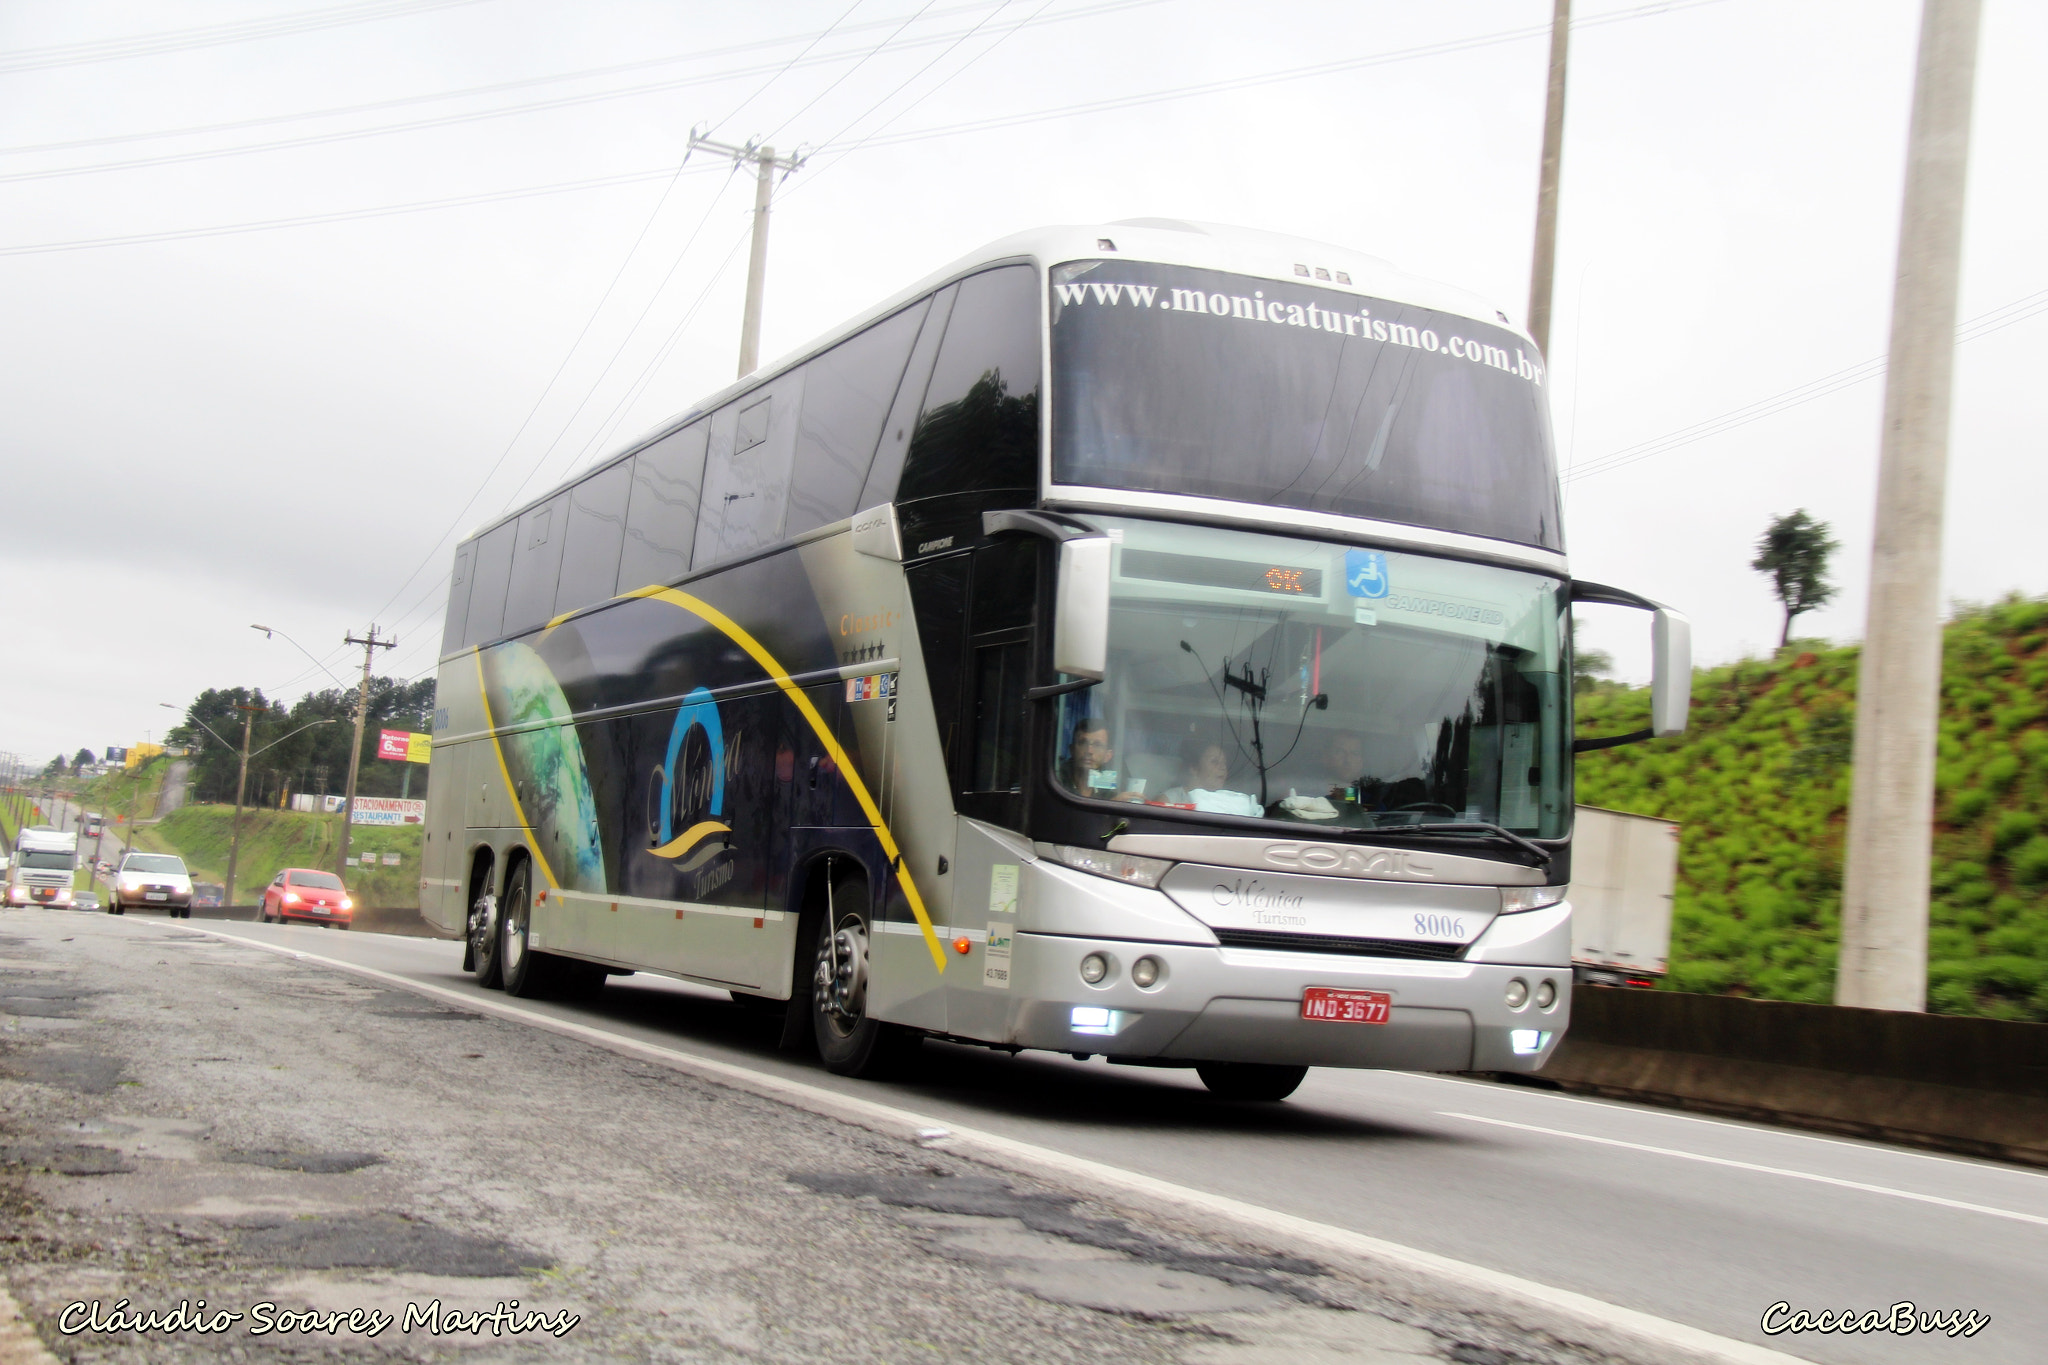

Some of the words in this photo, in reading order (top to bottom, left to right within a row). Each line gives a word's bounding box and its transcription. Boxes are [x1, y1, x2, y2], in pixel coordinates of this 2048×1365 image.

[1054, 282, 1542, 387] www.monicaturismo.com.br
[1266, 568, 1303, 592] OK
[840, 606, 893, 636] Classic
[1384, 593, 1480, 621] CAMPIONE
[1480, 608, 1505, 626] HD
[354, 798, 411, 812] STACIONAMENTO
[1262, 843, 1435, 877] COMIL
[694, 859, 734, 900] Turismo
[1211, 878, 1304, 910] Mónica
[1253, 910, 1307, 927] Turismo
[1413, 912, 1466, 939] 8006
